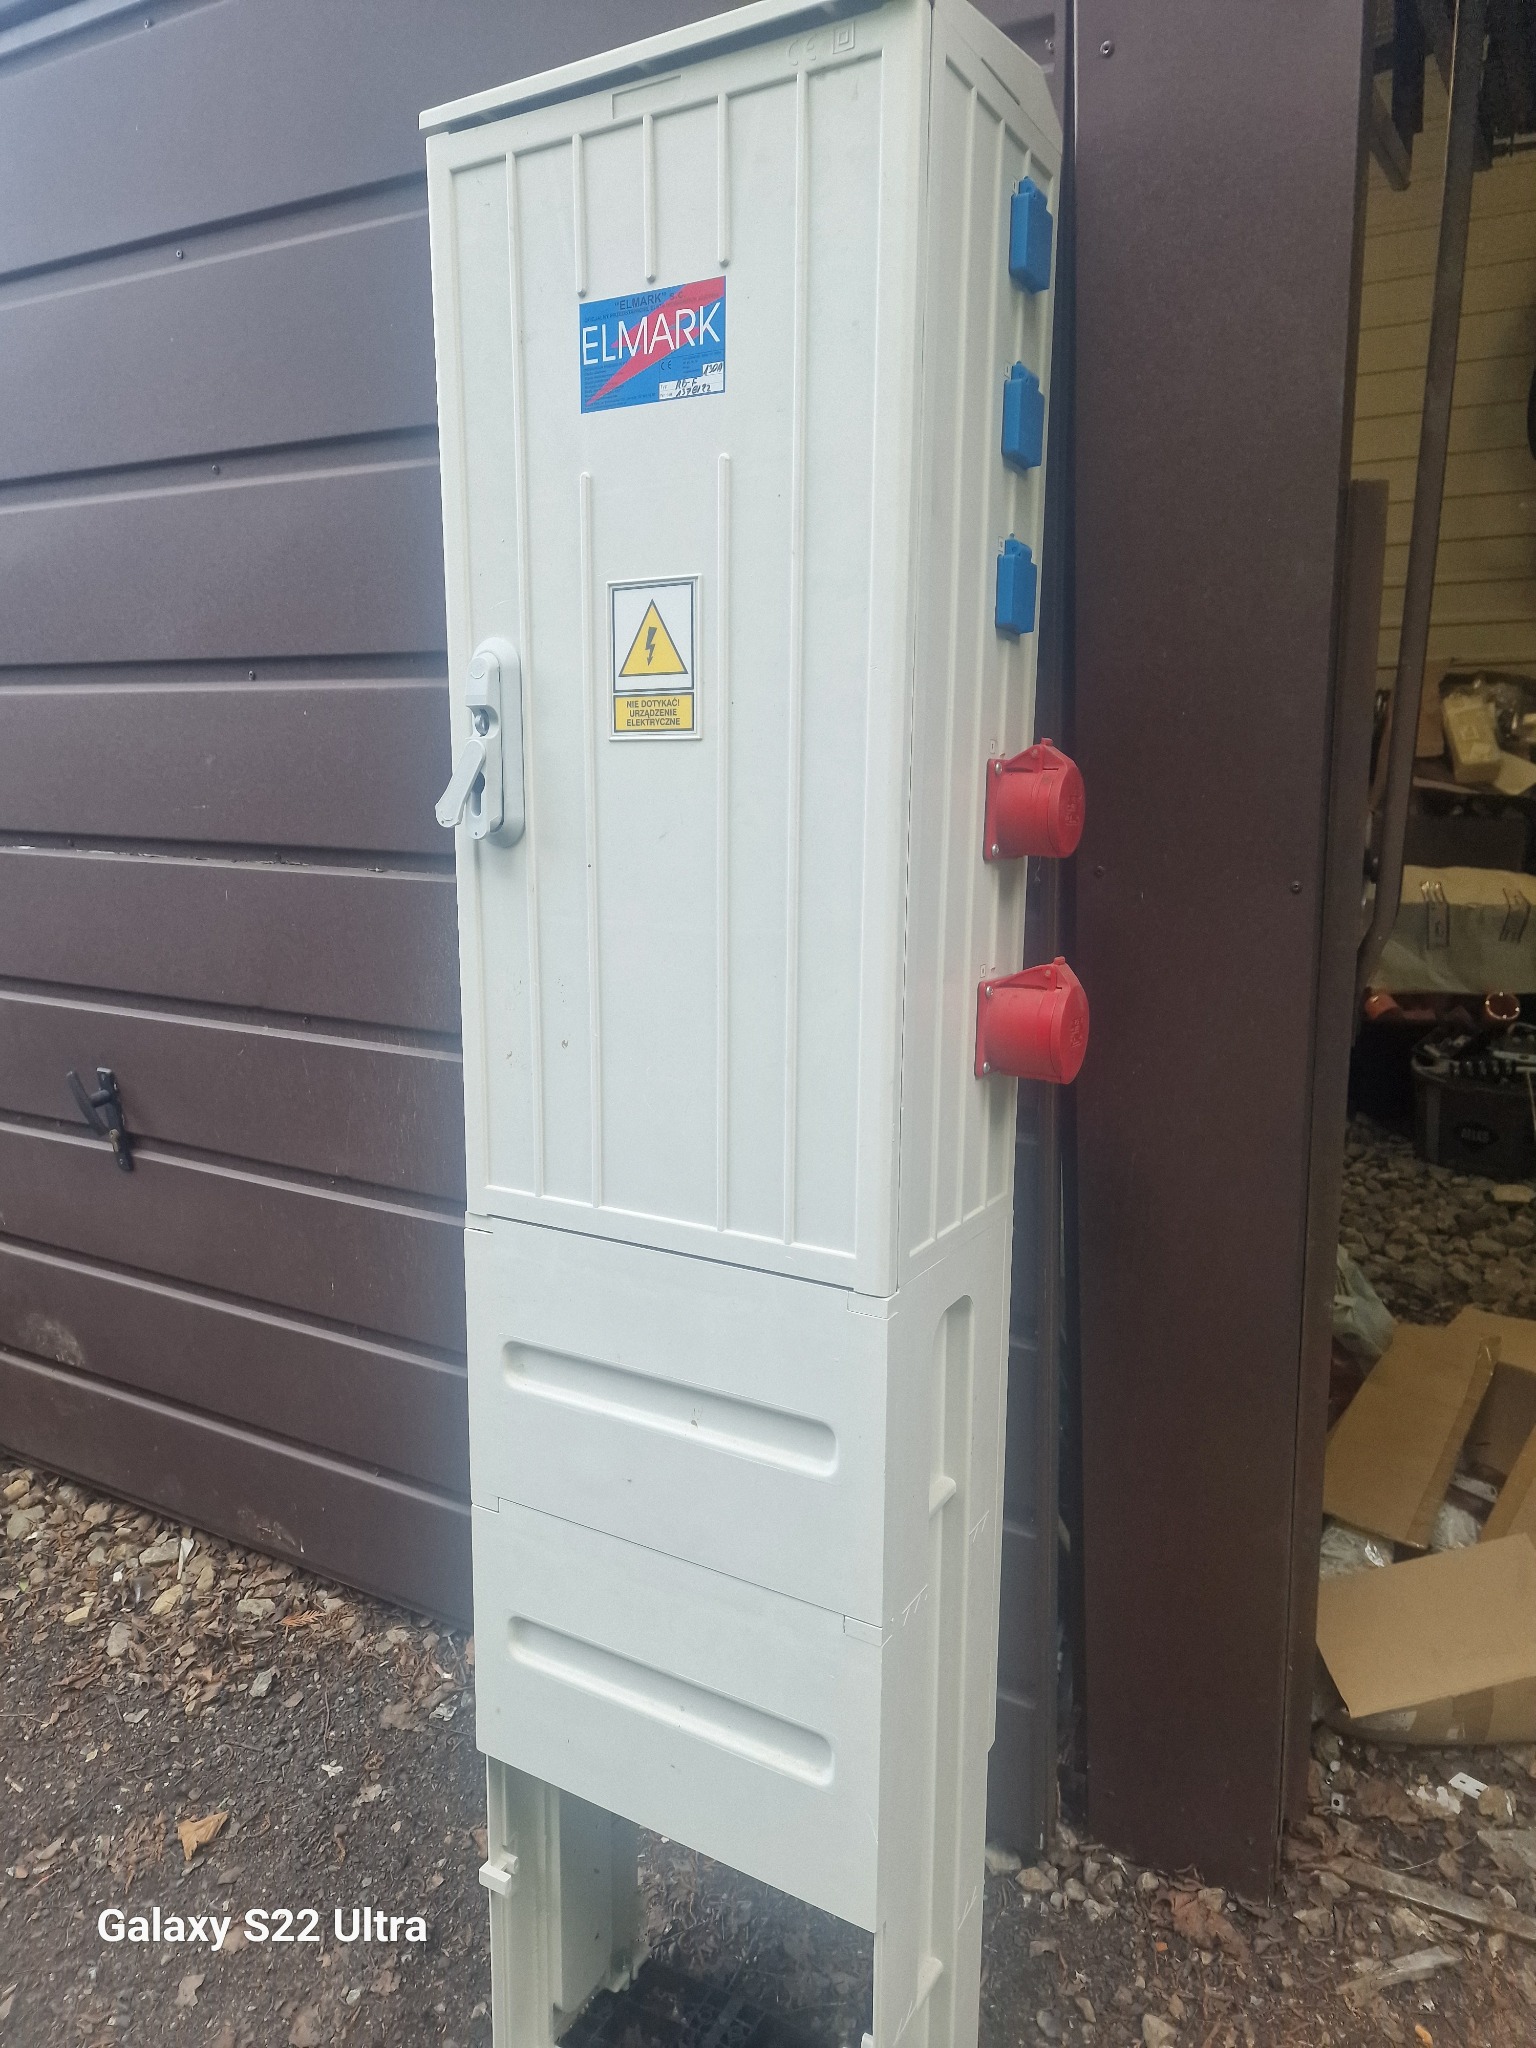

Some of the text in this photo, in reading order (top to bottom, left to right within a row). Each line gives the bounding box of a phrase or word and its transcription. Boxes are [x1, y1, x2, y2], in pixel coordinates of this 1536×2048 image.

[582, 302, 721, 365] ELMARK
[626, 697, 680, 708] NIE DOTYKAĆ!
[629, 708, 678, 718] URZĄDZENIE
[626, 718, 681, 727] ELEKTRYCZNE
